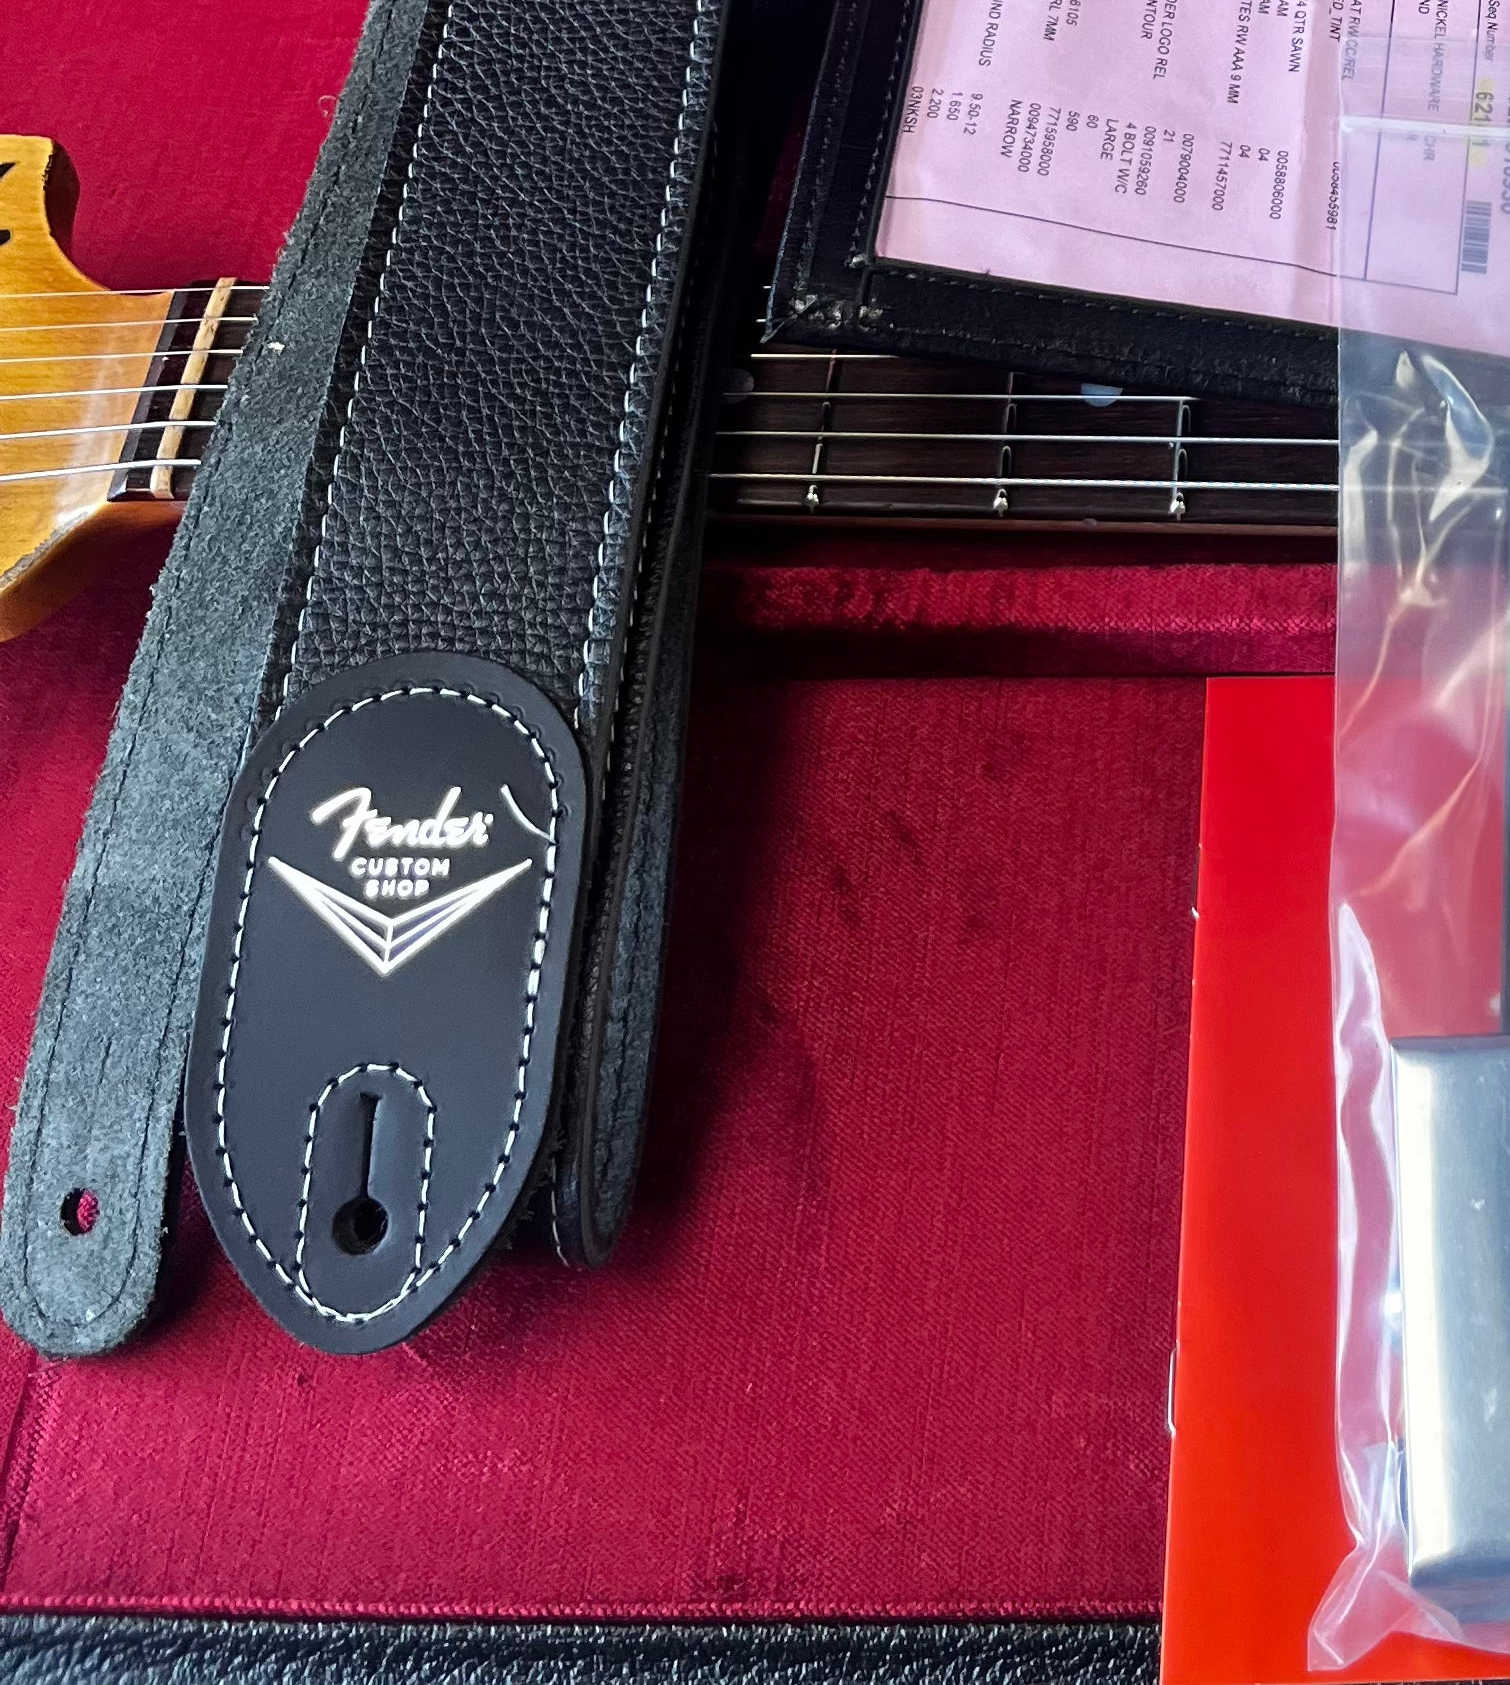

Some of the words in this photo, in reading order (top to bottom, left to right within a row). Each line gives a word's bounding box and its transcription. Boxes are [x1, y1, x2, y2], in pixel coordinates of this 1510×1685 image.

[1043, 15, 1058, 41] 7MM
[1427, 42, 1443, 112] HARDWARE
[900, 84, 924, 135] 03NKSH
[1211, 141, 1232, 211] 7711457000
[350, 856, 450, 878] CUSTOM
[364, 879, 430, 899] SHOP
